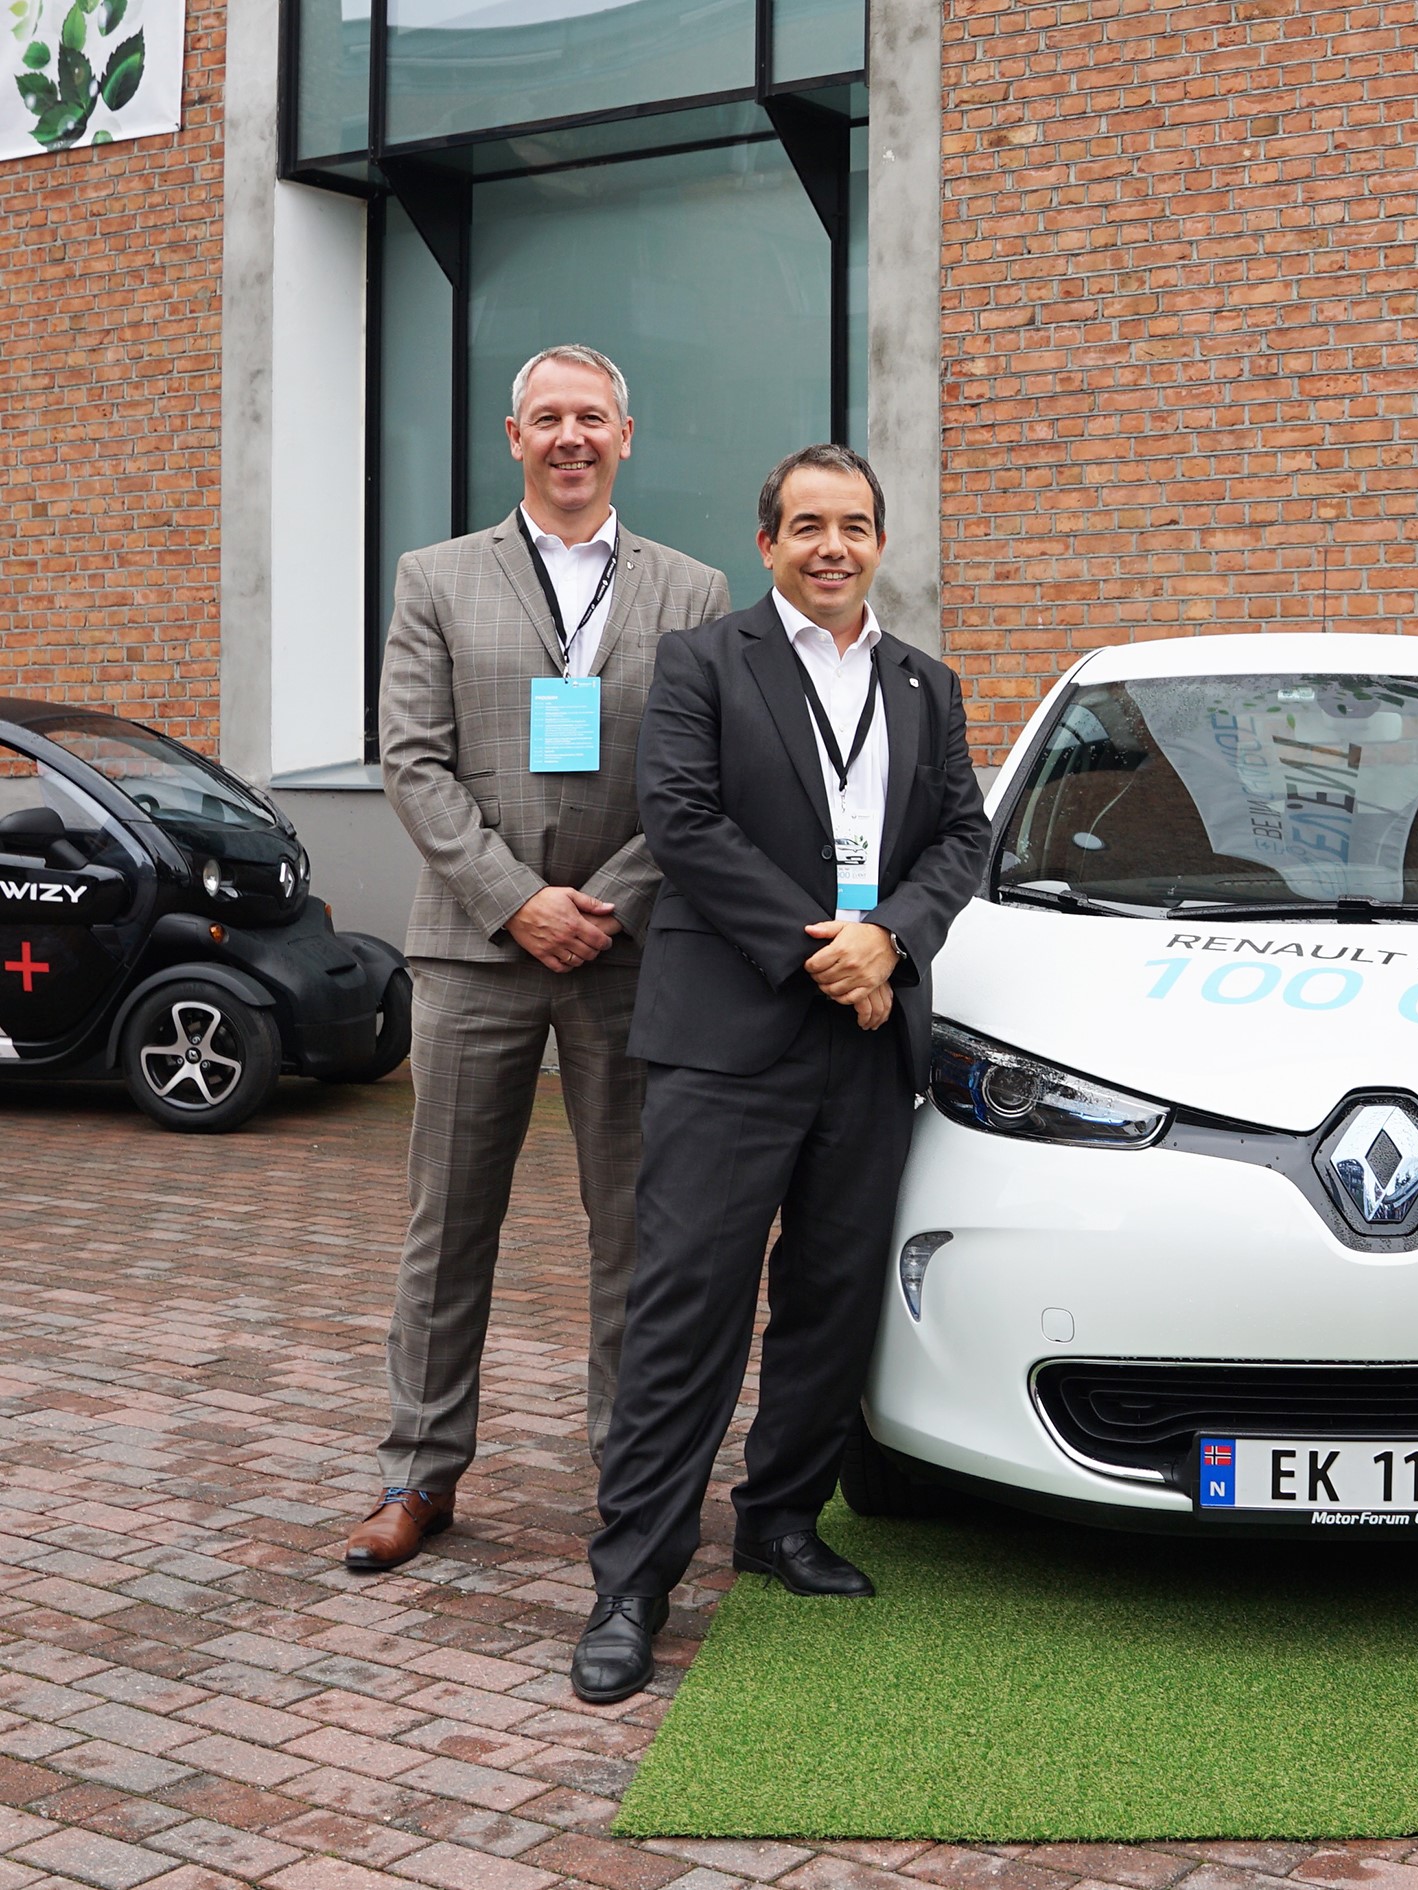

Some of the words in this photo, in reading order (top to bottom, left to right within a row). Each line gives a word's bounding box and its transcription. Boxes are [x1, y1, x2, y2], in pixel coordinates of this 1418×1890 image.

[0, 880, 88, 903] WIZY
[1166, 933, 1408, 965] RENAULT
[1144, 957, 1364, 1011] 100
[1210, 1481, 1225, 1497] N
[1271, 1449, 1341, 1501] EK
